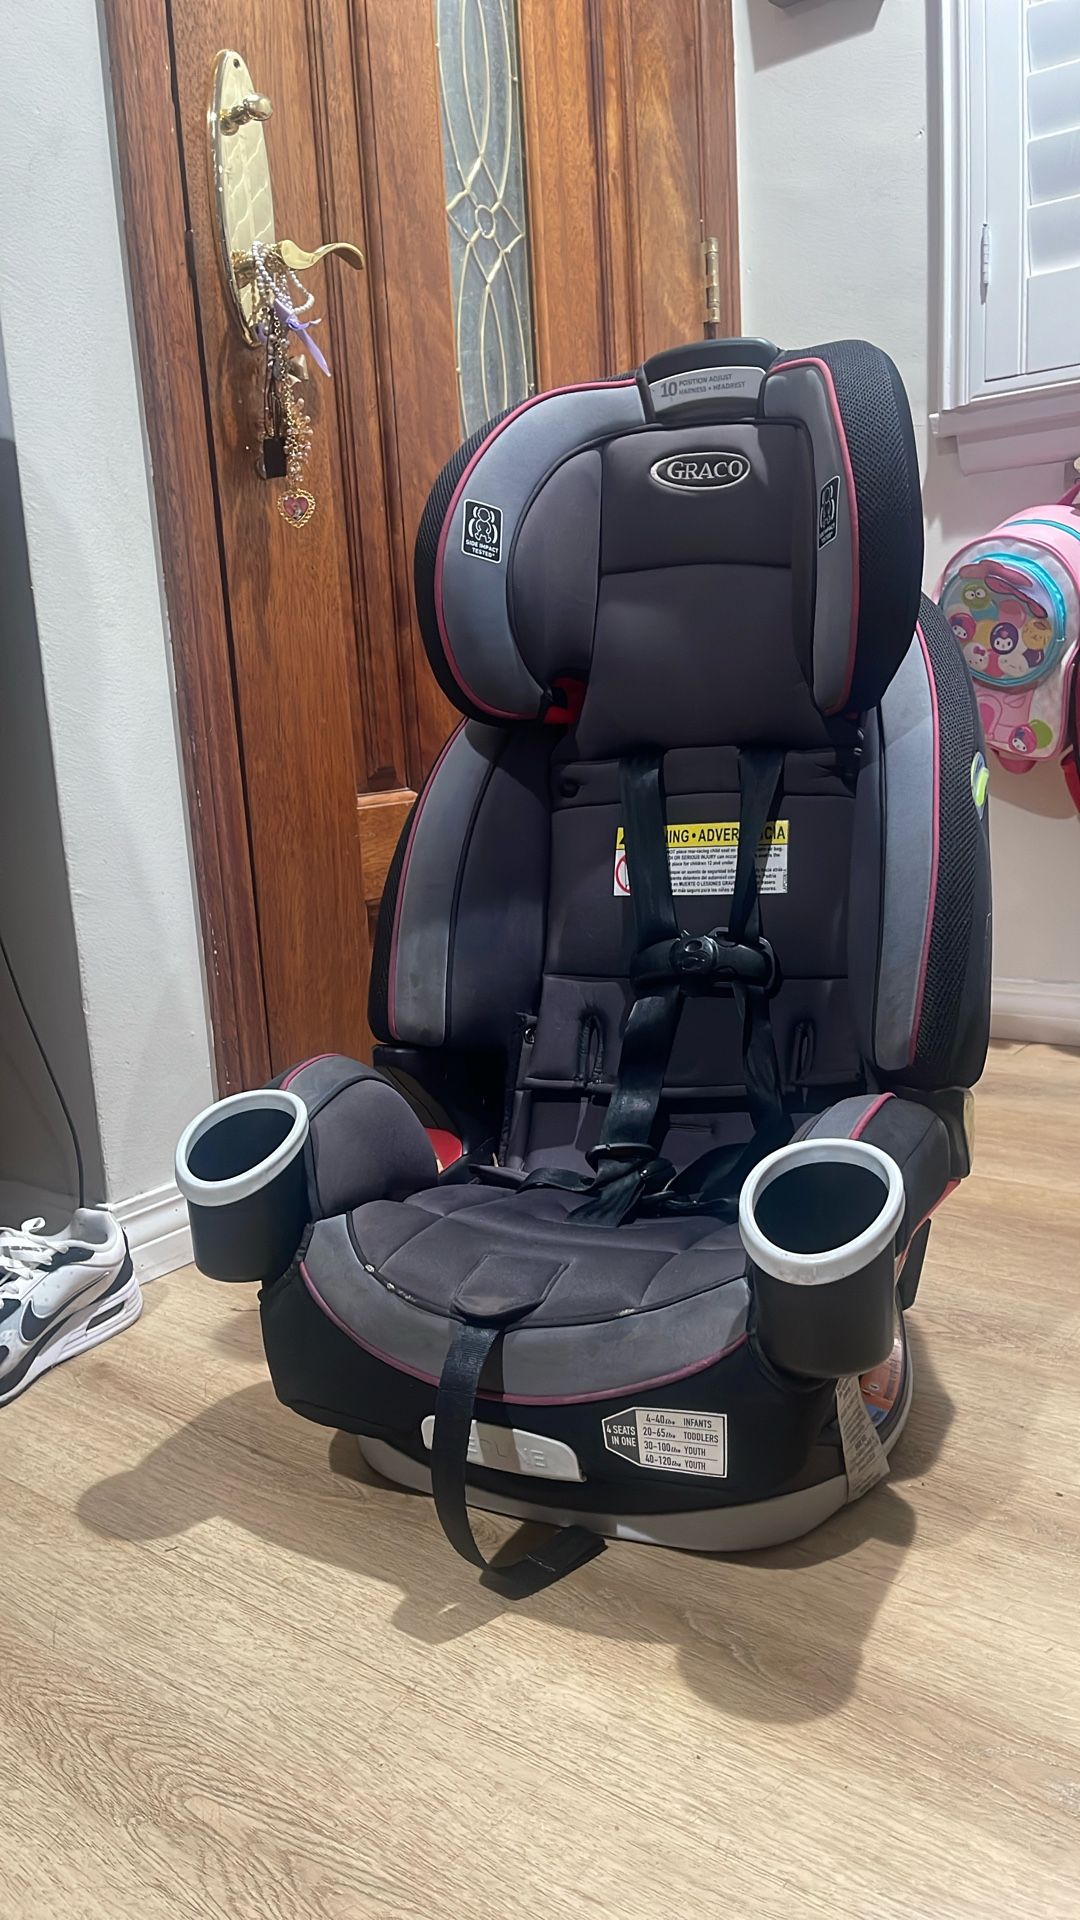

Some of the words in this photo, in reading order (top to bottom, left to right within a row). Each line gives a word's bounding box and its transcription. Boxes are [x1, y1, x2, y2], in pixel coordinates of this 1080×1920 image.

[679, 377, 707, 386] POSITION
[709, 374, 732, 382] ADJUST
[661, 381, 678, 397] 10
[679, 385, 707, 395] HARNESS
[713, 381, 745, 391] HEADREST
[667, 460, 743, 480] GRACO
[465, 539, 478, 548] SIDE
[479, 543, 499, 553] IMPACT
[698, 826, 786, 842] ADVERCIA
[683, 1417, 712, 1429] INFANTS
[606, 1425, 612, 1433] 4
[612, 1425, 636, 1436] SEATS
[611, 1435, 619, 1445] IN
[621, 1436, 637, 1447] ONE
[684, 1431, 719, 1443] TODDLERS
[684, 1446, 706, 1457] YOUTH
[684, 1460, 706, 1471] YOUTH
